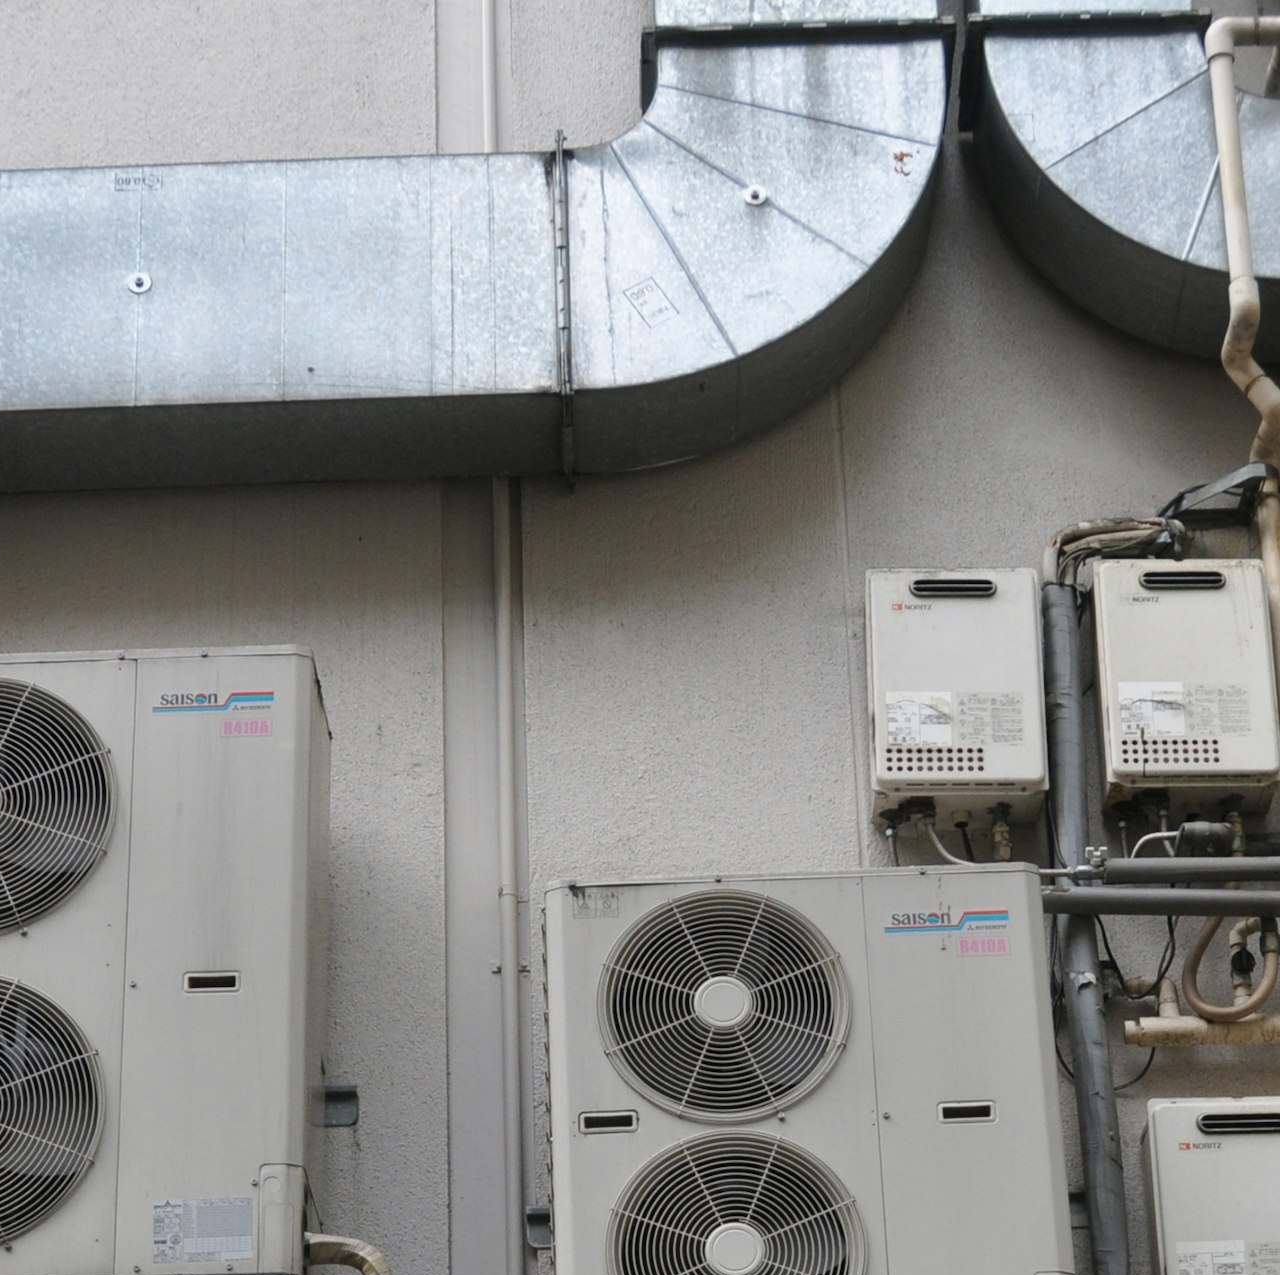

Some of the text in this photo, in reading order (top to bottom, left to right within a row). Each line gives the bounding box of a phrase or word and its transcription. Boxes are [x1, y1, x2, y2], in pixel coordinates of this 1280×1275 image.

[160, 692, 218, 706] saison
[891, 911, 951, 926] saison
[959, 938, 1007, 954] R410A
[1192, 1142, 1222, 1150] NORITZ
